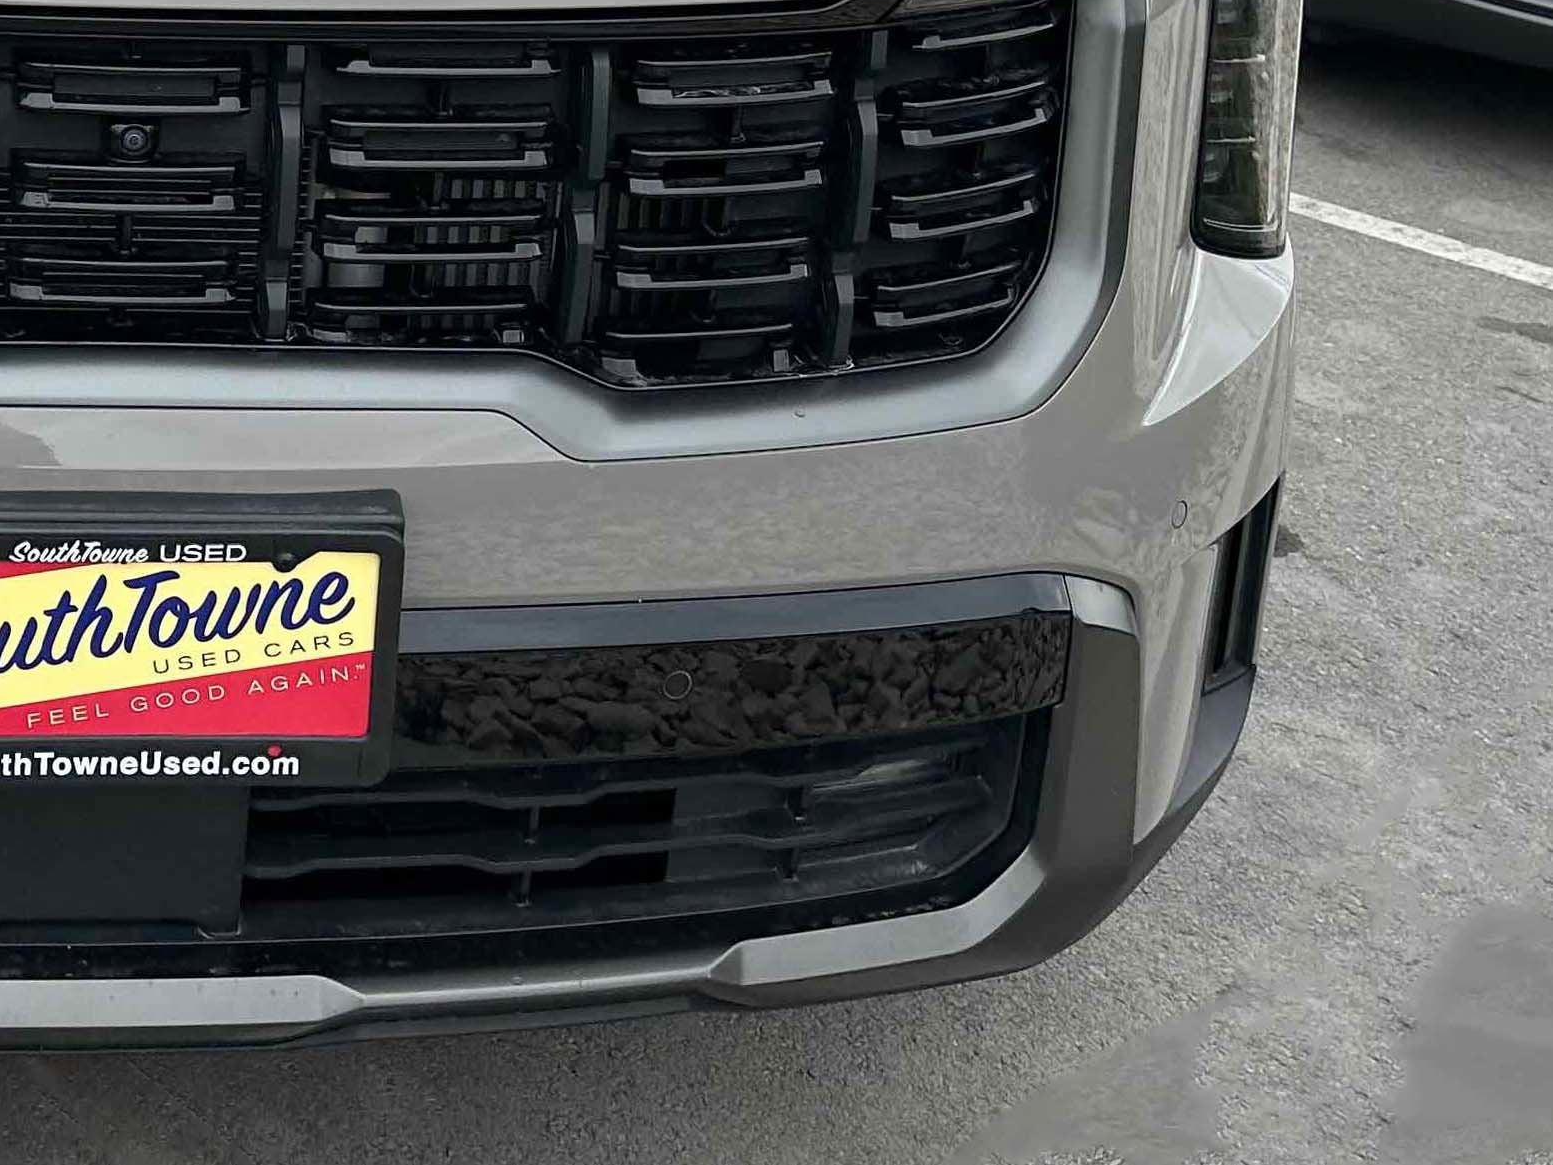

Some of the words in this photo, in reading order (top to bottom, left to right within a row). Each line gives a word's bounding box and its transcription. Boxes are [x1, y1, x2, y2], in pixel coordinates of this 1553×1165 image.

[9, 541, 149, 564] SouthTowne
[160, 544, 247, 562] USED
[153, 648, 241, 674] USED
[263, 631, 355, 659] CARS
[26, 702, 109, 729] FEEL
[130, 685, 225, 713] GOOD
